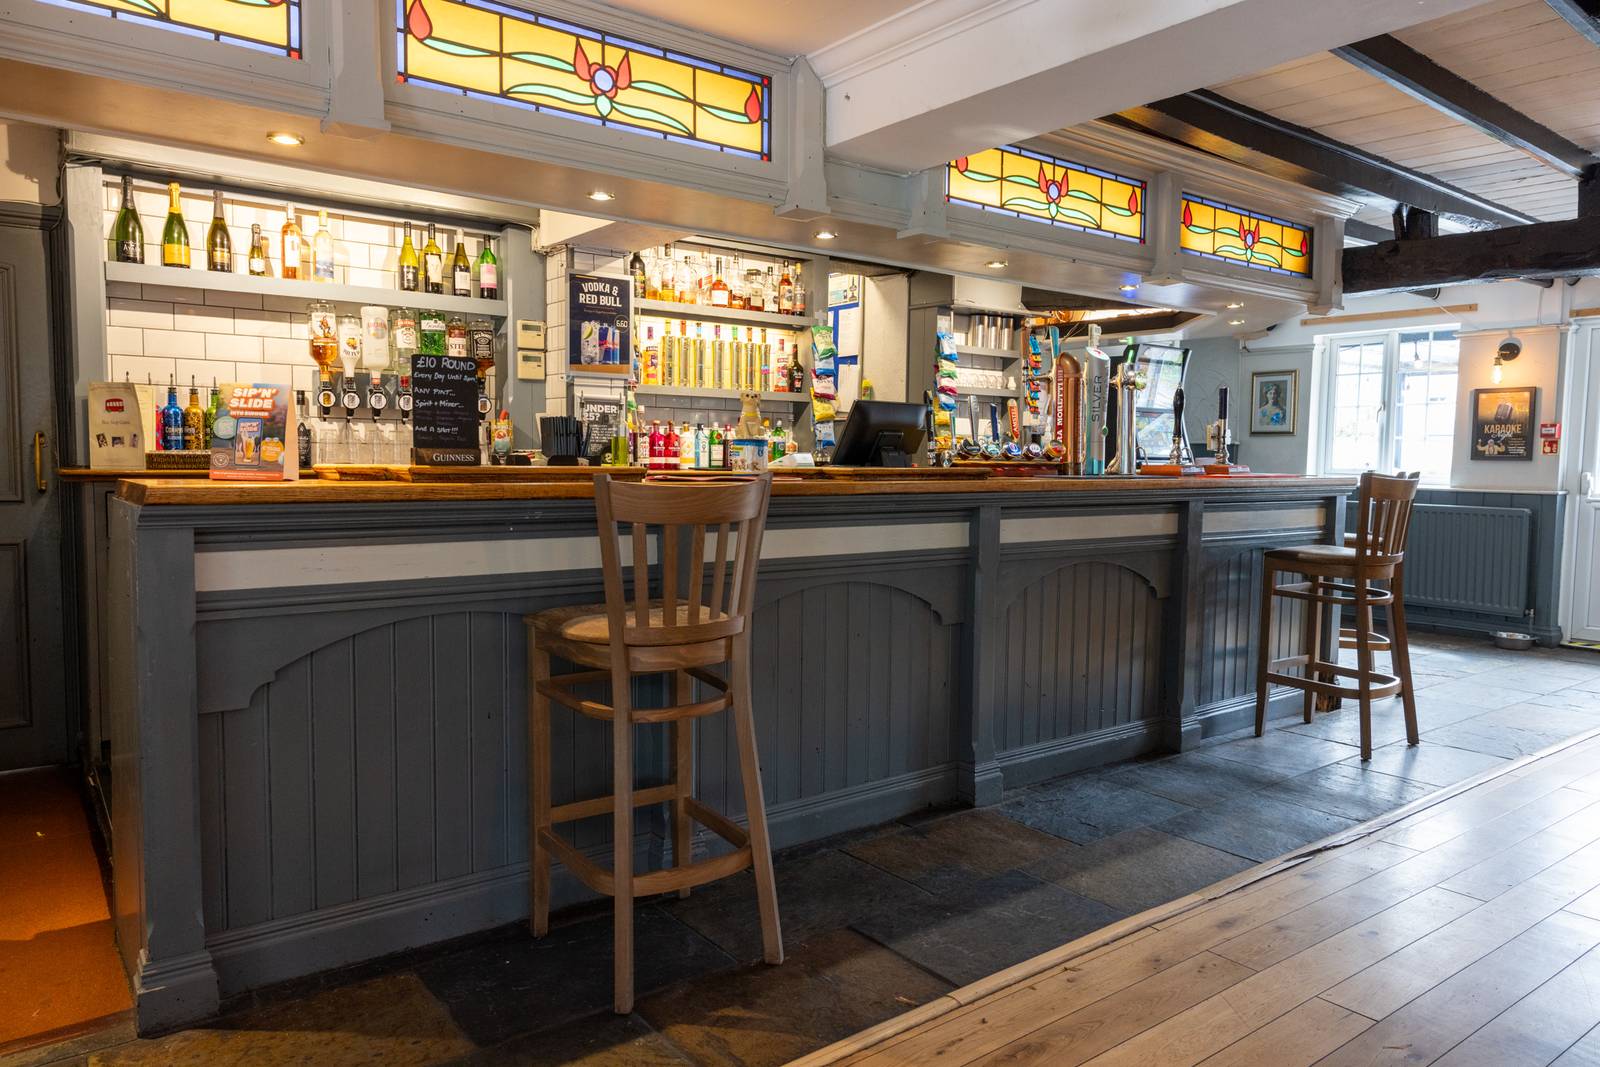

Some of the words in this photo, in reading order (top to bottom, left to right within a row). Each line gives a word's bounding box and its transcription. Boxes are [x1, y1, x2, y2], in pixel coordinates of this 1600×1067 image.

[582, 282, 610, 293] VODKA
[612, 286, 619, 296] &
[579, 293, 598, 304] RED
[600, 295, 622, 307] BULL
[416, 357, 436, 368] £10
[441, 357, 476, 371] ROUND
[414, 372, 432, 380] Every
[434, 372, 445, 382] Day
[233, 388, 277, 398] SIP'N'
[229, 398, 273, 409] SLIDE
[1092, 375, 1102, 422] SILVER
[415, 400, 434, 408] Spirit
[1484, 424, 1522, 434] KARAOKE
[432, 453, 475, 462] GUINNESS
